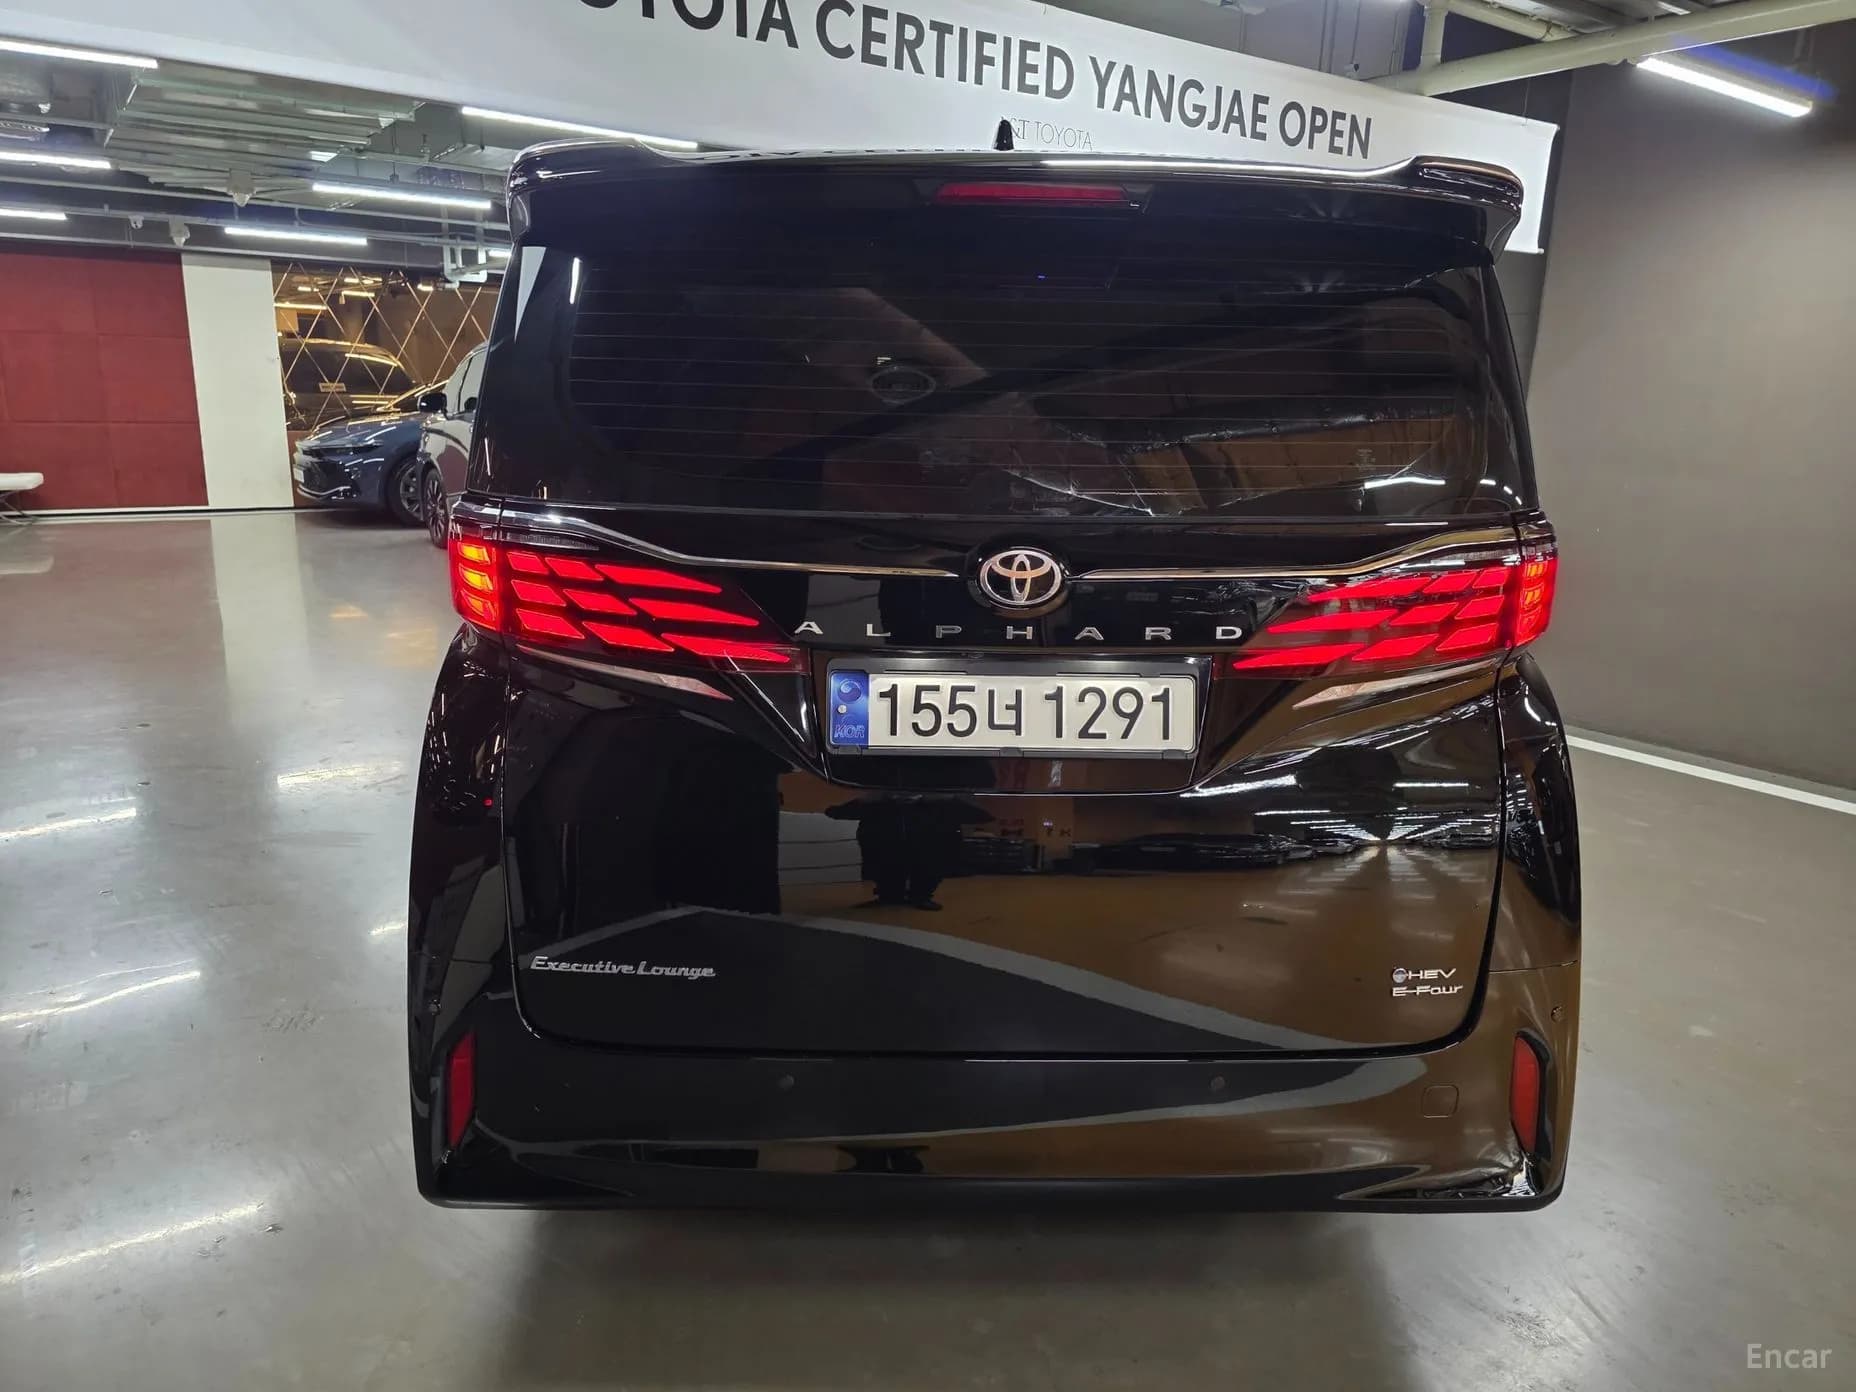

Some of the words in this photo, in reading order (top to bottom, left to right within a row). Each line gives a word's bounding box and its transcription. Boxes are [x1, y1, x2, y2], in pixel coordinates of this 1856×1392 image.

[815, 0, 1074, 100] CERTIFIED
[1089, 55, 1270, 141] YANGJAE
[1279, 101, 1372, 159] OPEN
[1035, 121, 1093, 151] TOYOTA
[794, 621, 1243, 641] ALPHARD
[878, 683, 1022, 738] 155너
[1045, 686, 1170, 740] 1291
[834, 724, 866, 738] KOR
[530, 956, 635, 975] Executive
[637, 961, 716, 980] Lounge
[1392, 985, 1464, 997] E-Four
